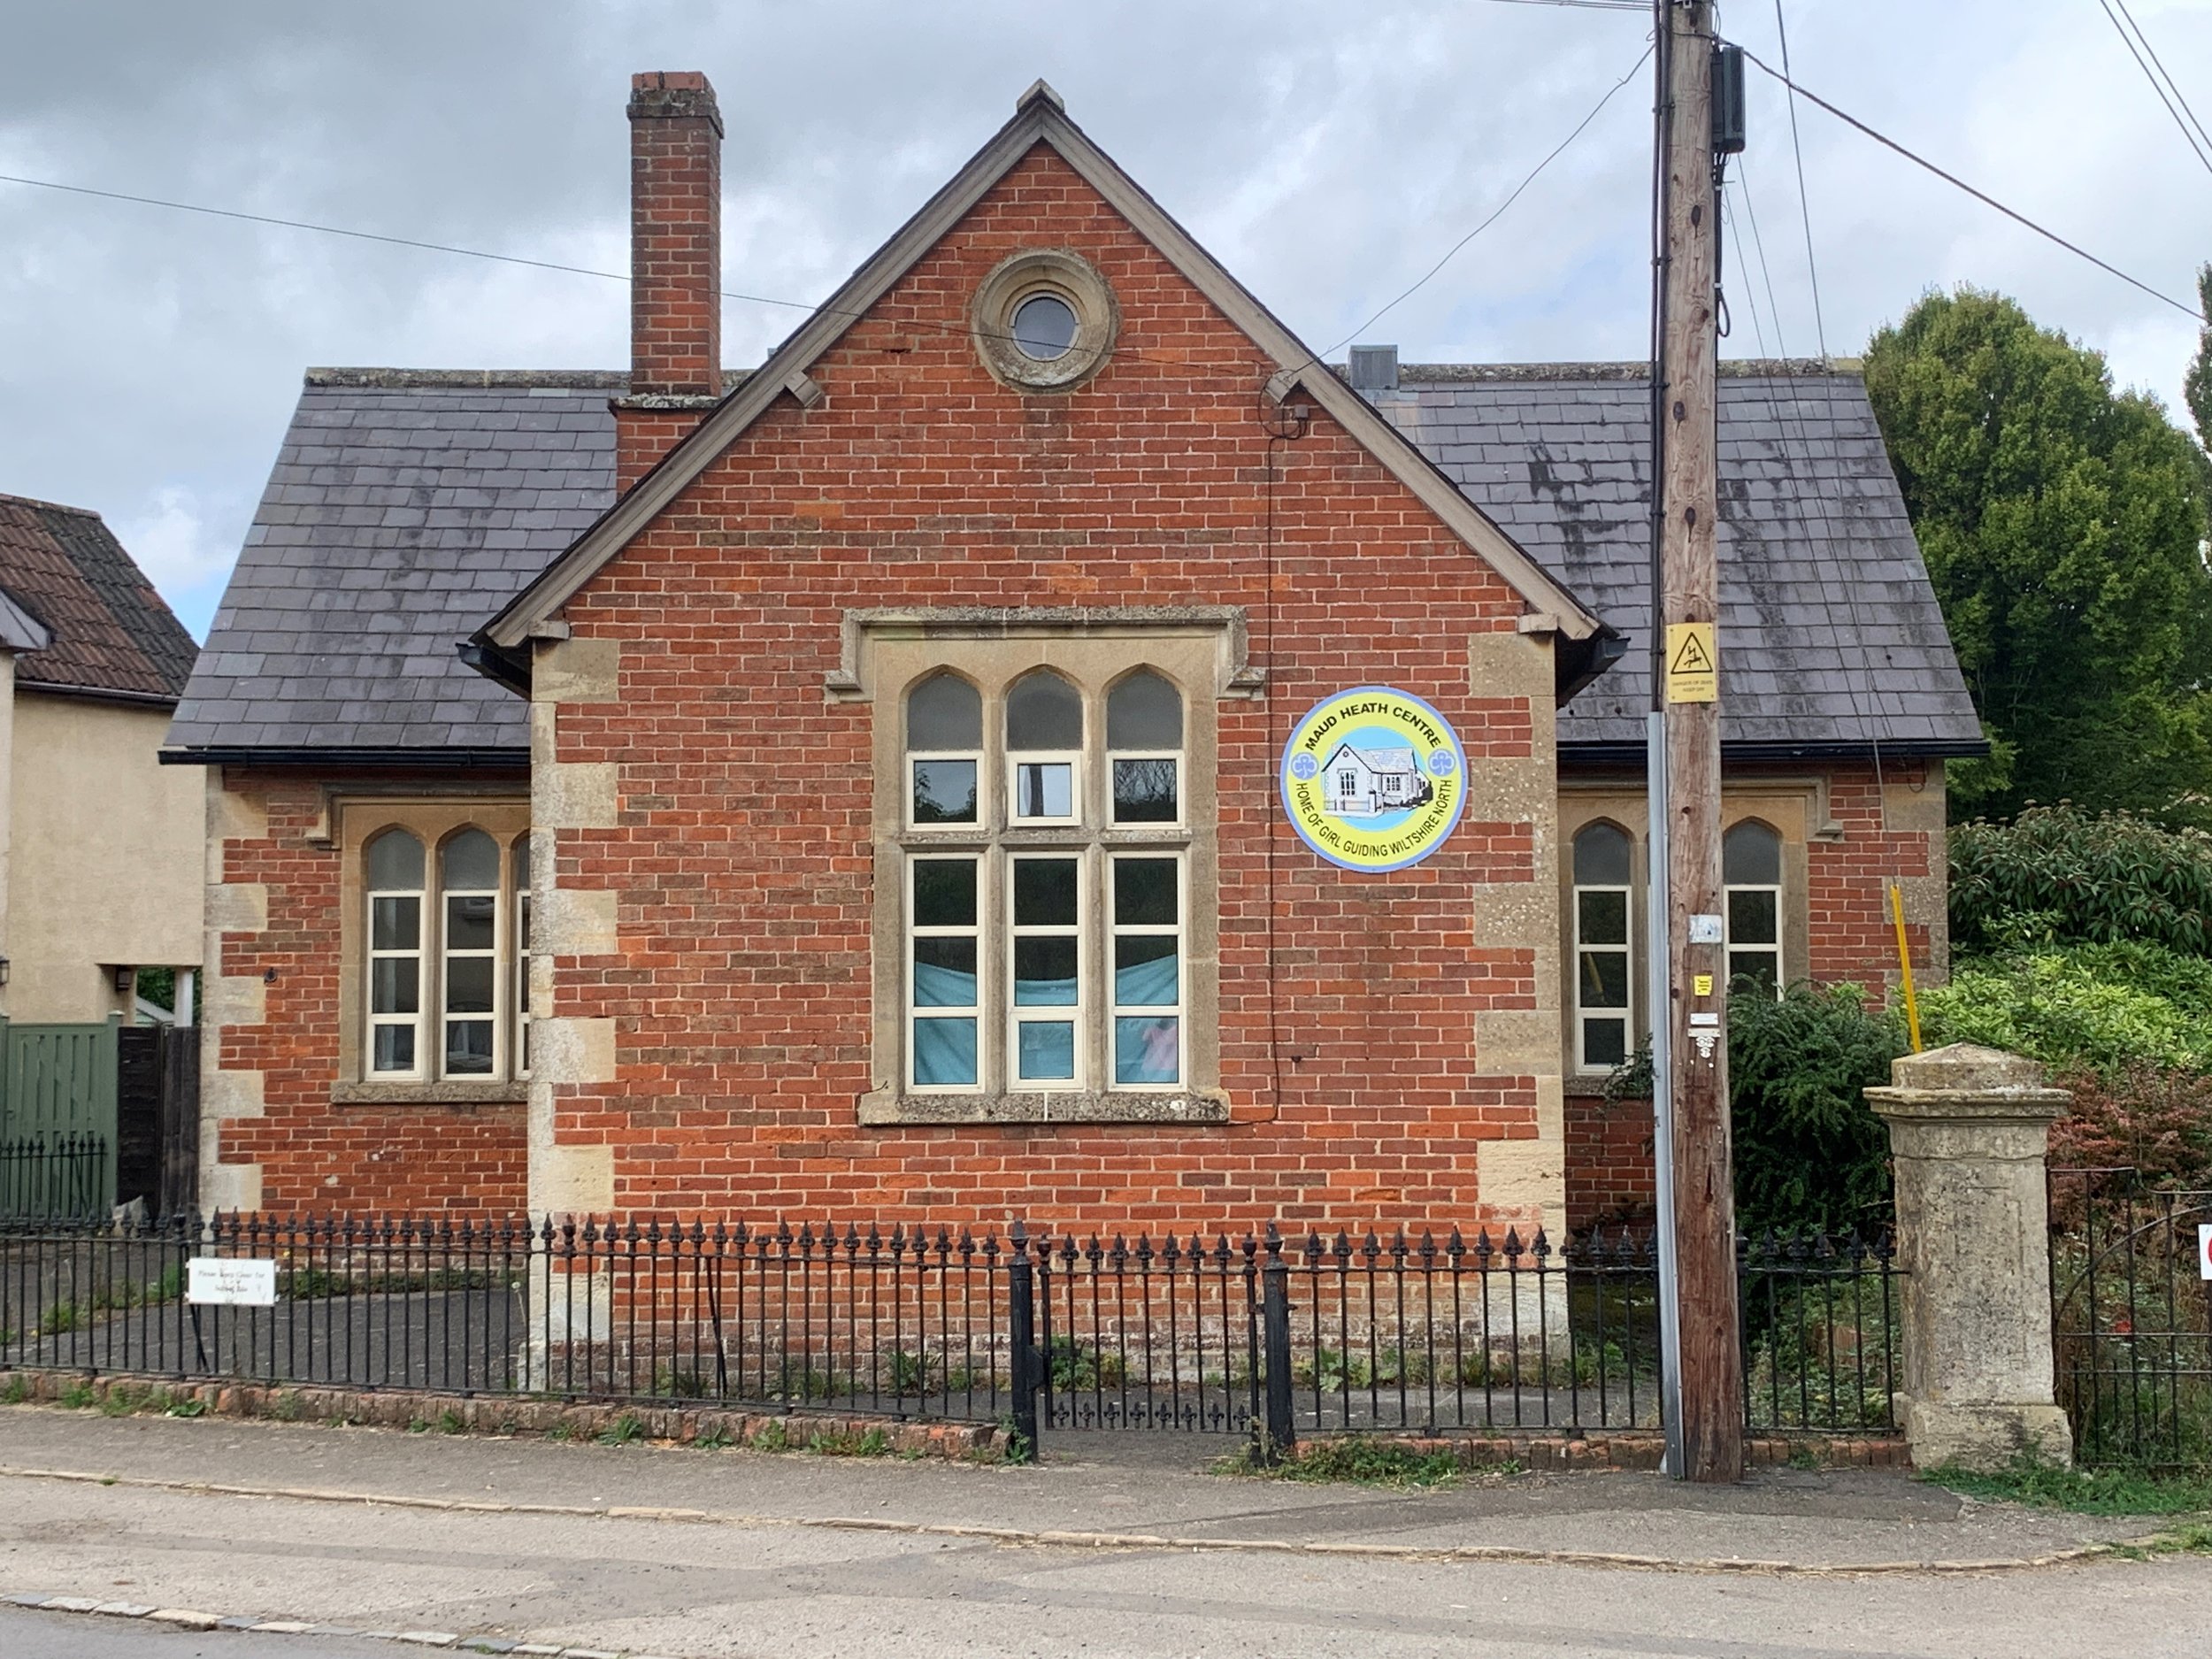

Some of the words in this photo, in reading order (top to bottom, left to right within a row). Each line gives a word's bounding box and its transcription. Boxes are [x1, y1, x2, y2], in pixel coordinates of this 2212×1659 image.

[1305, 716, 1338, 751] MAUD
[1340, 703, 1388, 719] HEATH
[1393, 706, 1441, 749] CENTRE
[1296, 782, 1315, 815] HOME
[1308, 813, 1324, 827] OF
[1319, 826, 1340, 848] GIRL
[1343, 841, 1388, 856] GUIDING
[1390, 815, 1440, 855] WILTSHIRE
[1435, 780, 1452, 817] NORTH
